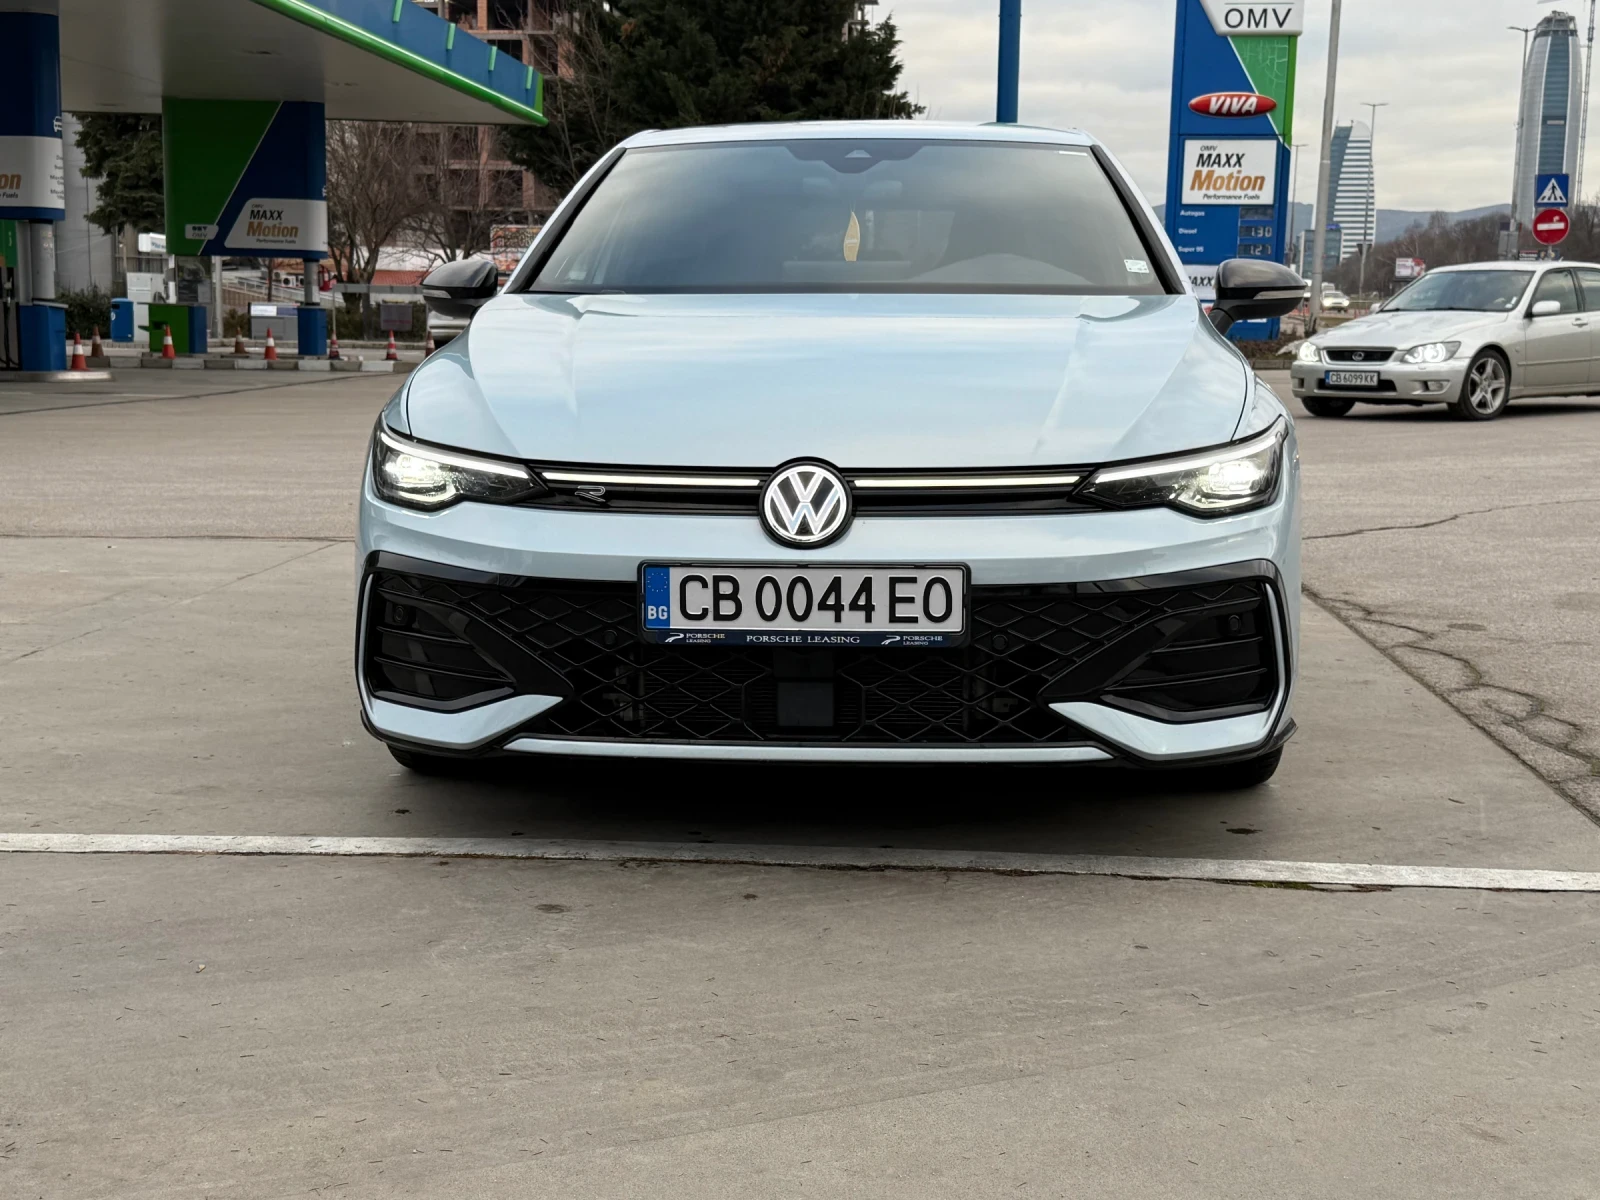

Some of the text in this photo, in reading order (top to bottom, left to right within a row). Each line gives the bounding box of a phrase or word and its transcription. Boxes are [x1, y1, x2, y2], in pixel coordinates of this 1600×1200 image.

[1224, 7, 1292, 29] OMV
[1208, 95, 1258, 114] VIVA
[1196, 153, 1245, 168] MAXX
[1189, 169, 1266, 192] Motion
[1203, 193, 1260, 201] Performance Fuels
[249, 209, 284, 221] MAXX
[1180, 209, 1205, 217] Autogas
[246, 221, 299, 238] Motion
[1178, 246, 1195, 254] Super
[1189, 276, 1215, 287] AXX
[1343, 374, 1363, 384] 6099
[1364, 374, 1375, 384] KK
[679, 574, 743, 622] CB
[755, 575, 875, 623] 0044
[647, 605, 668, 620] BG
[746, 635, 860, 643] PORSCHE LEASING
